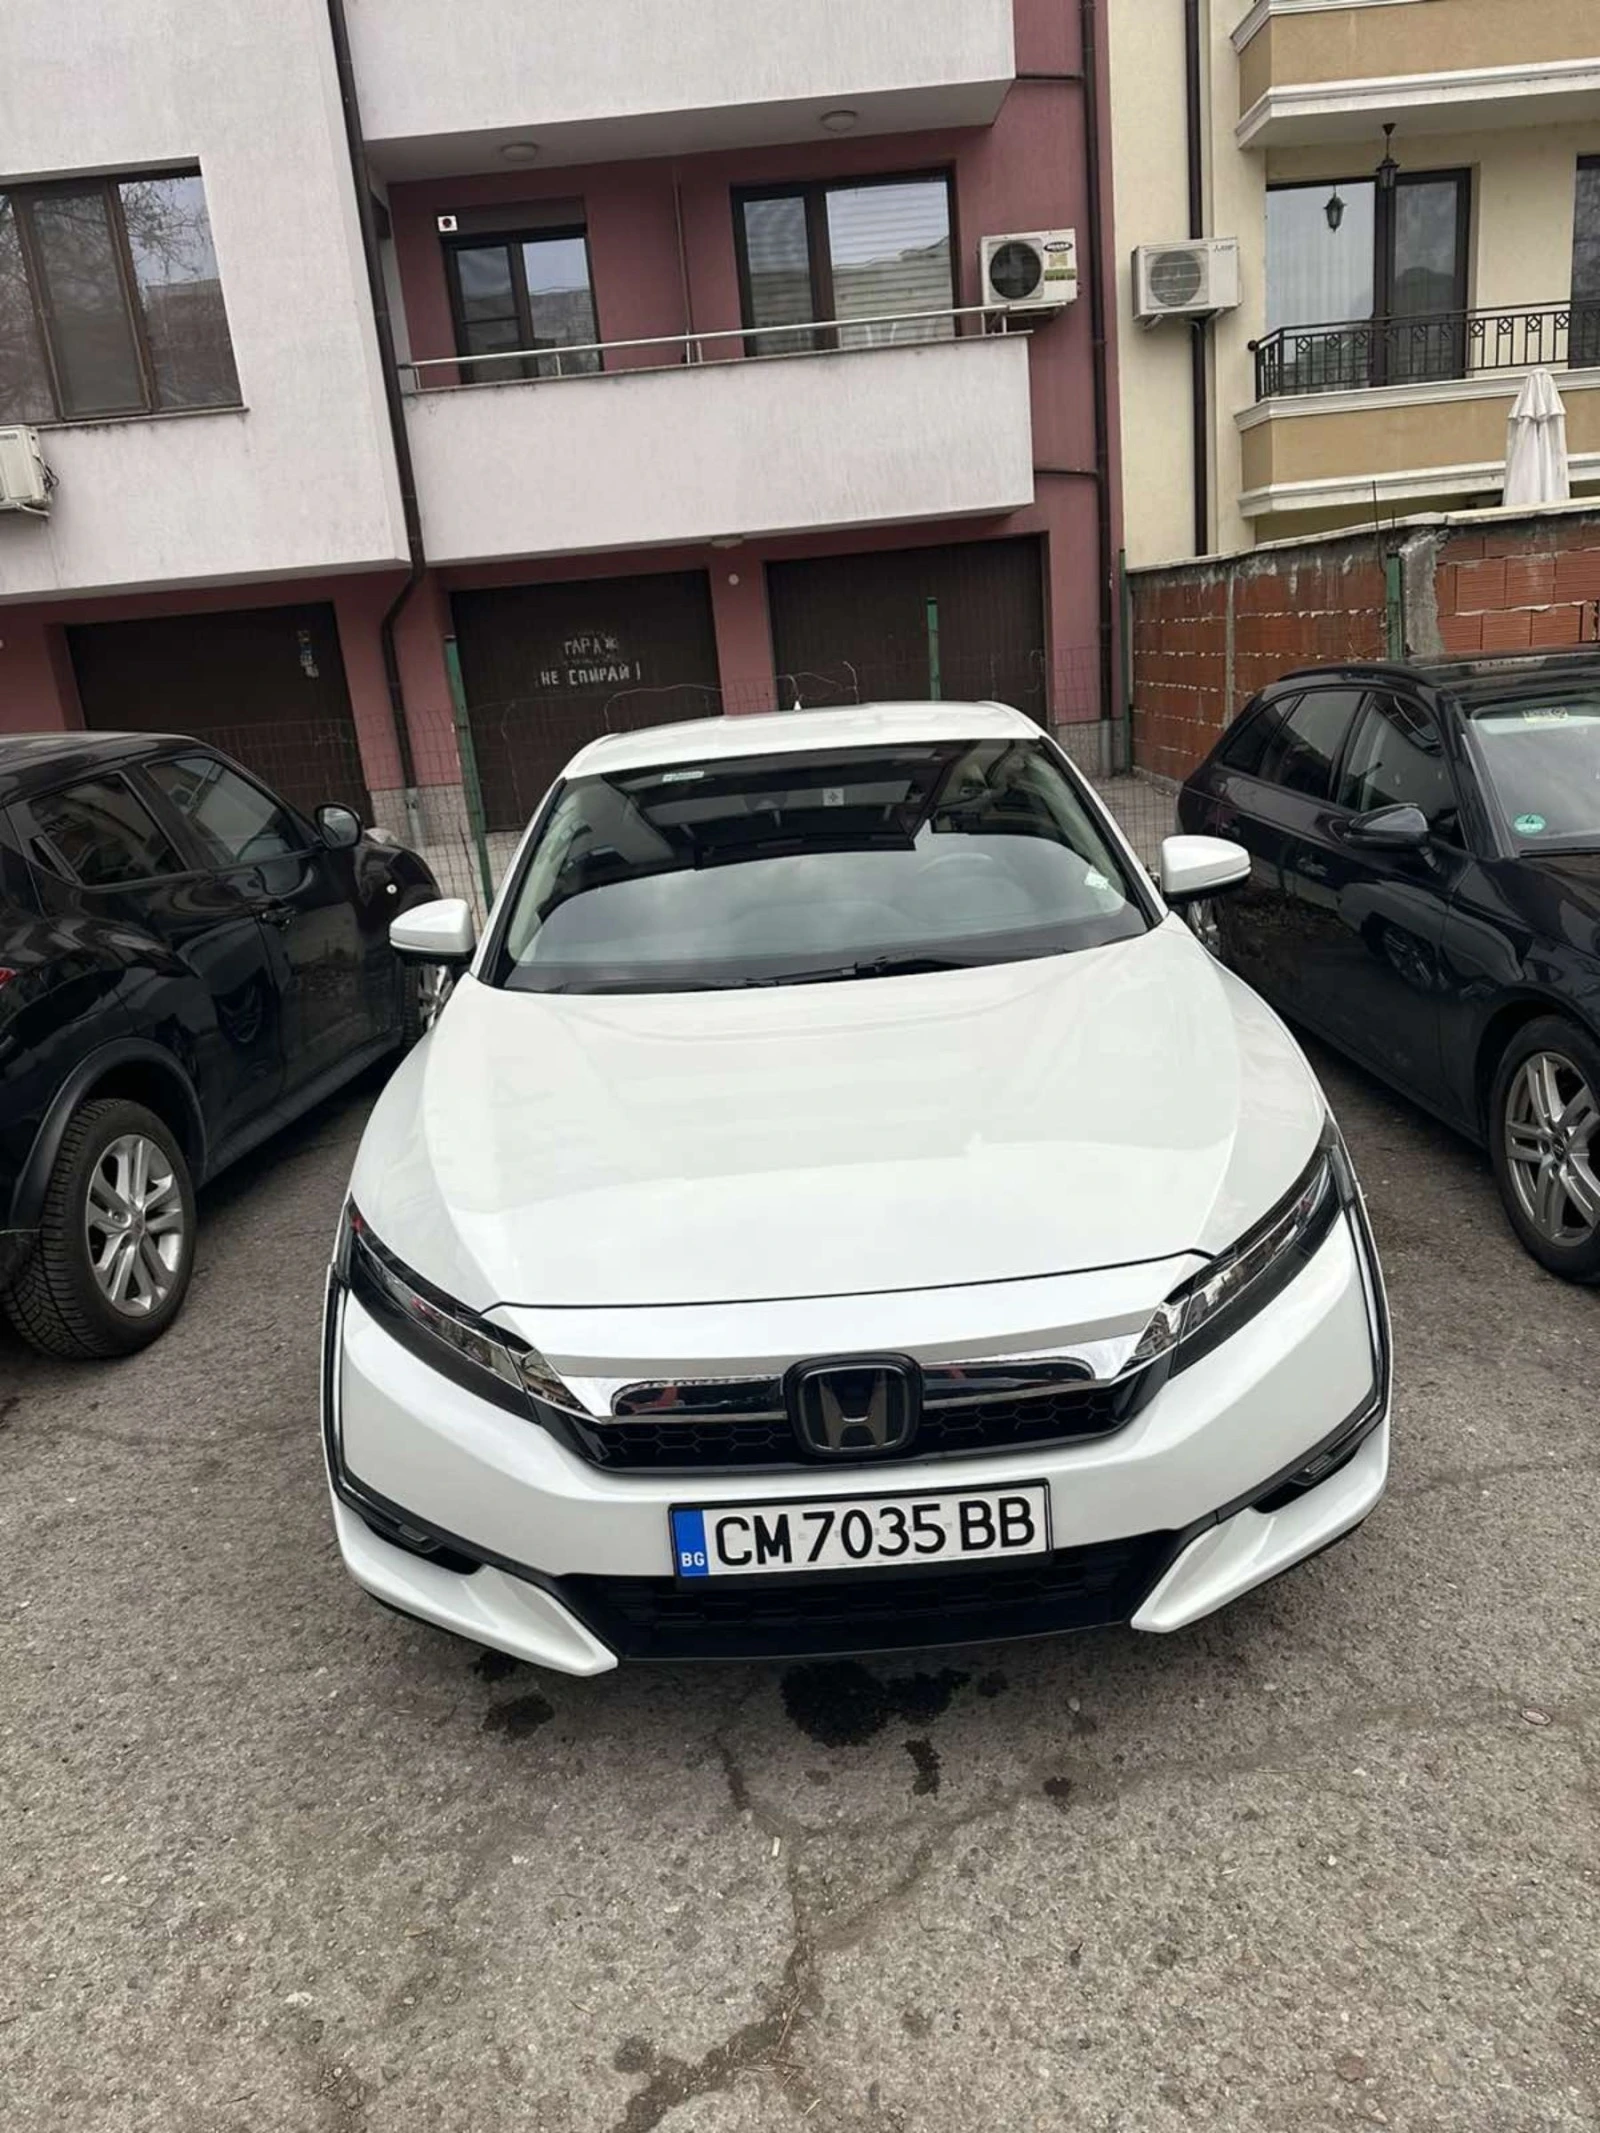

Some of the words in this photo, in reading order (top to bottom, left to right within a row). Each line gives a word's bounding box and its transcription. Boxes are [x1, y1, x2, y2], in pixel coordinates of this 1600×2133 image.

[540, 669, 559, 686] НЕ
[802, 1503, 946, 1562] 7035
[681, 1552, 705, 1567] BG
